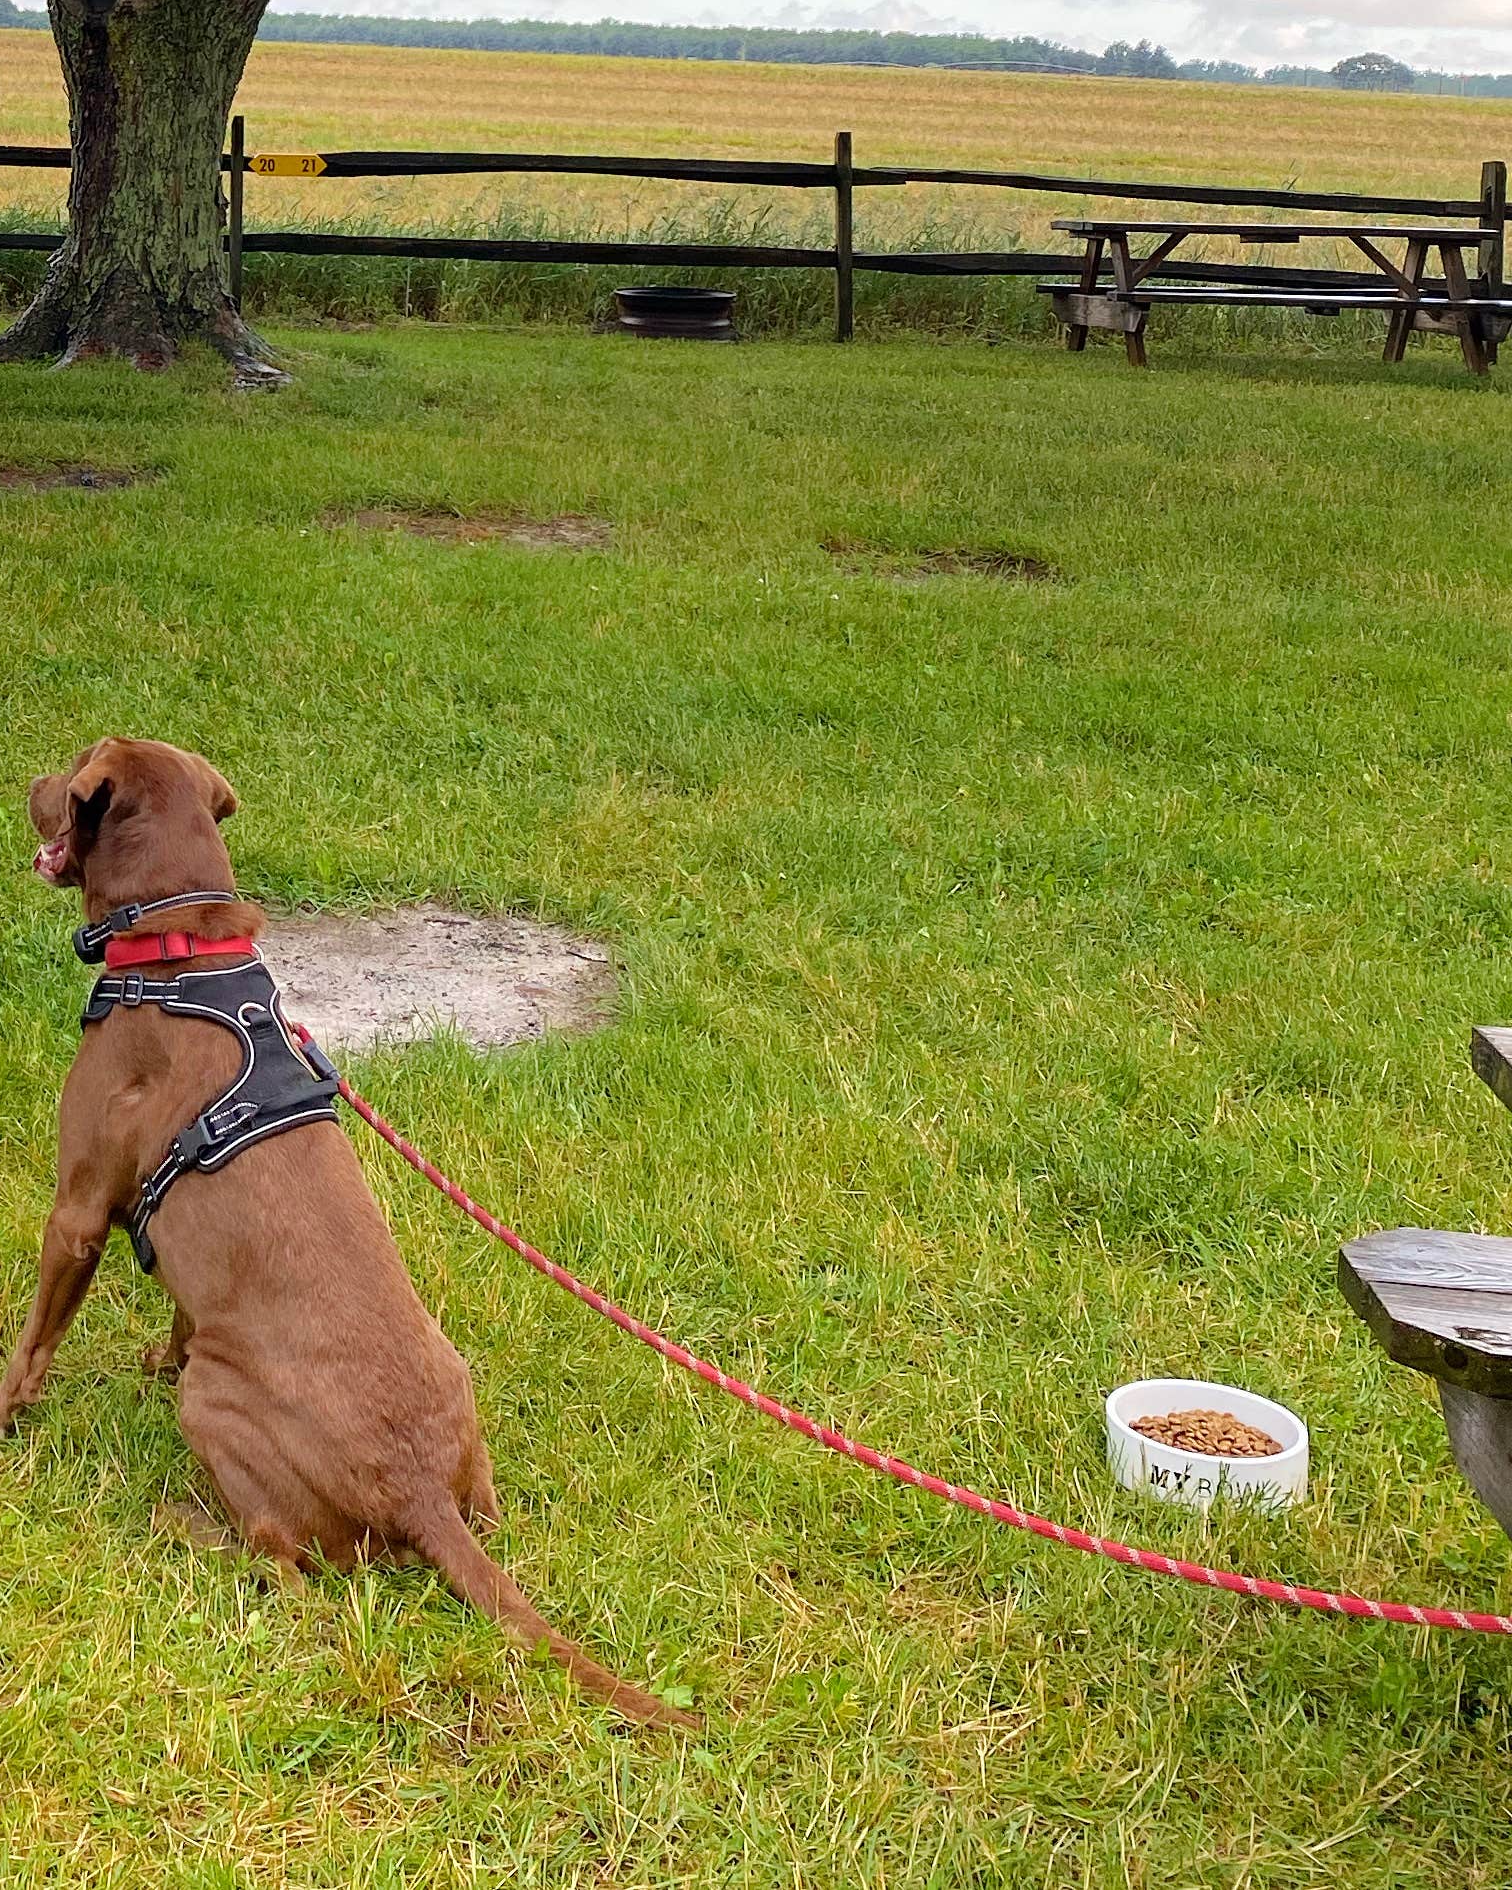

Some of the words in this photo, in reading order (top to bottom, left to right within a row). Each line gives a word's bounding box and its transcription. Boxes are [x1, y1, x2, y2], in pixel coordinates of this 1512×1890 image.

[259, 158, 275, 172] 20
[302, 159, 316, 172] 21
[1150, 1463, 1191, 1491] MY
